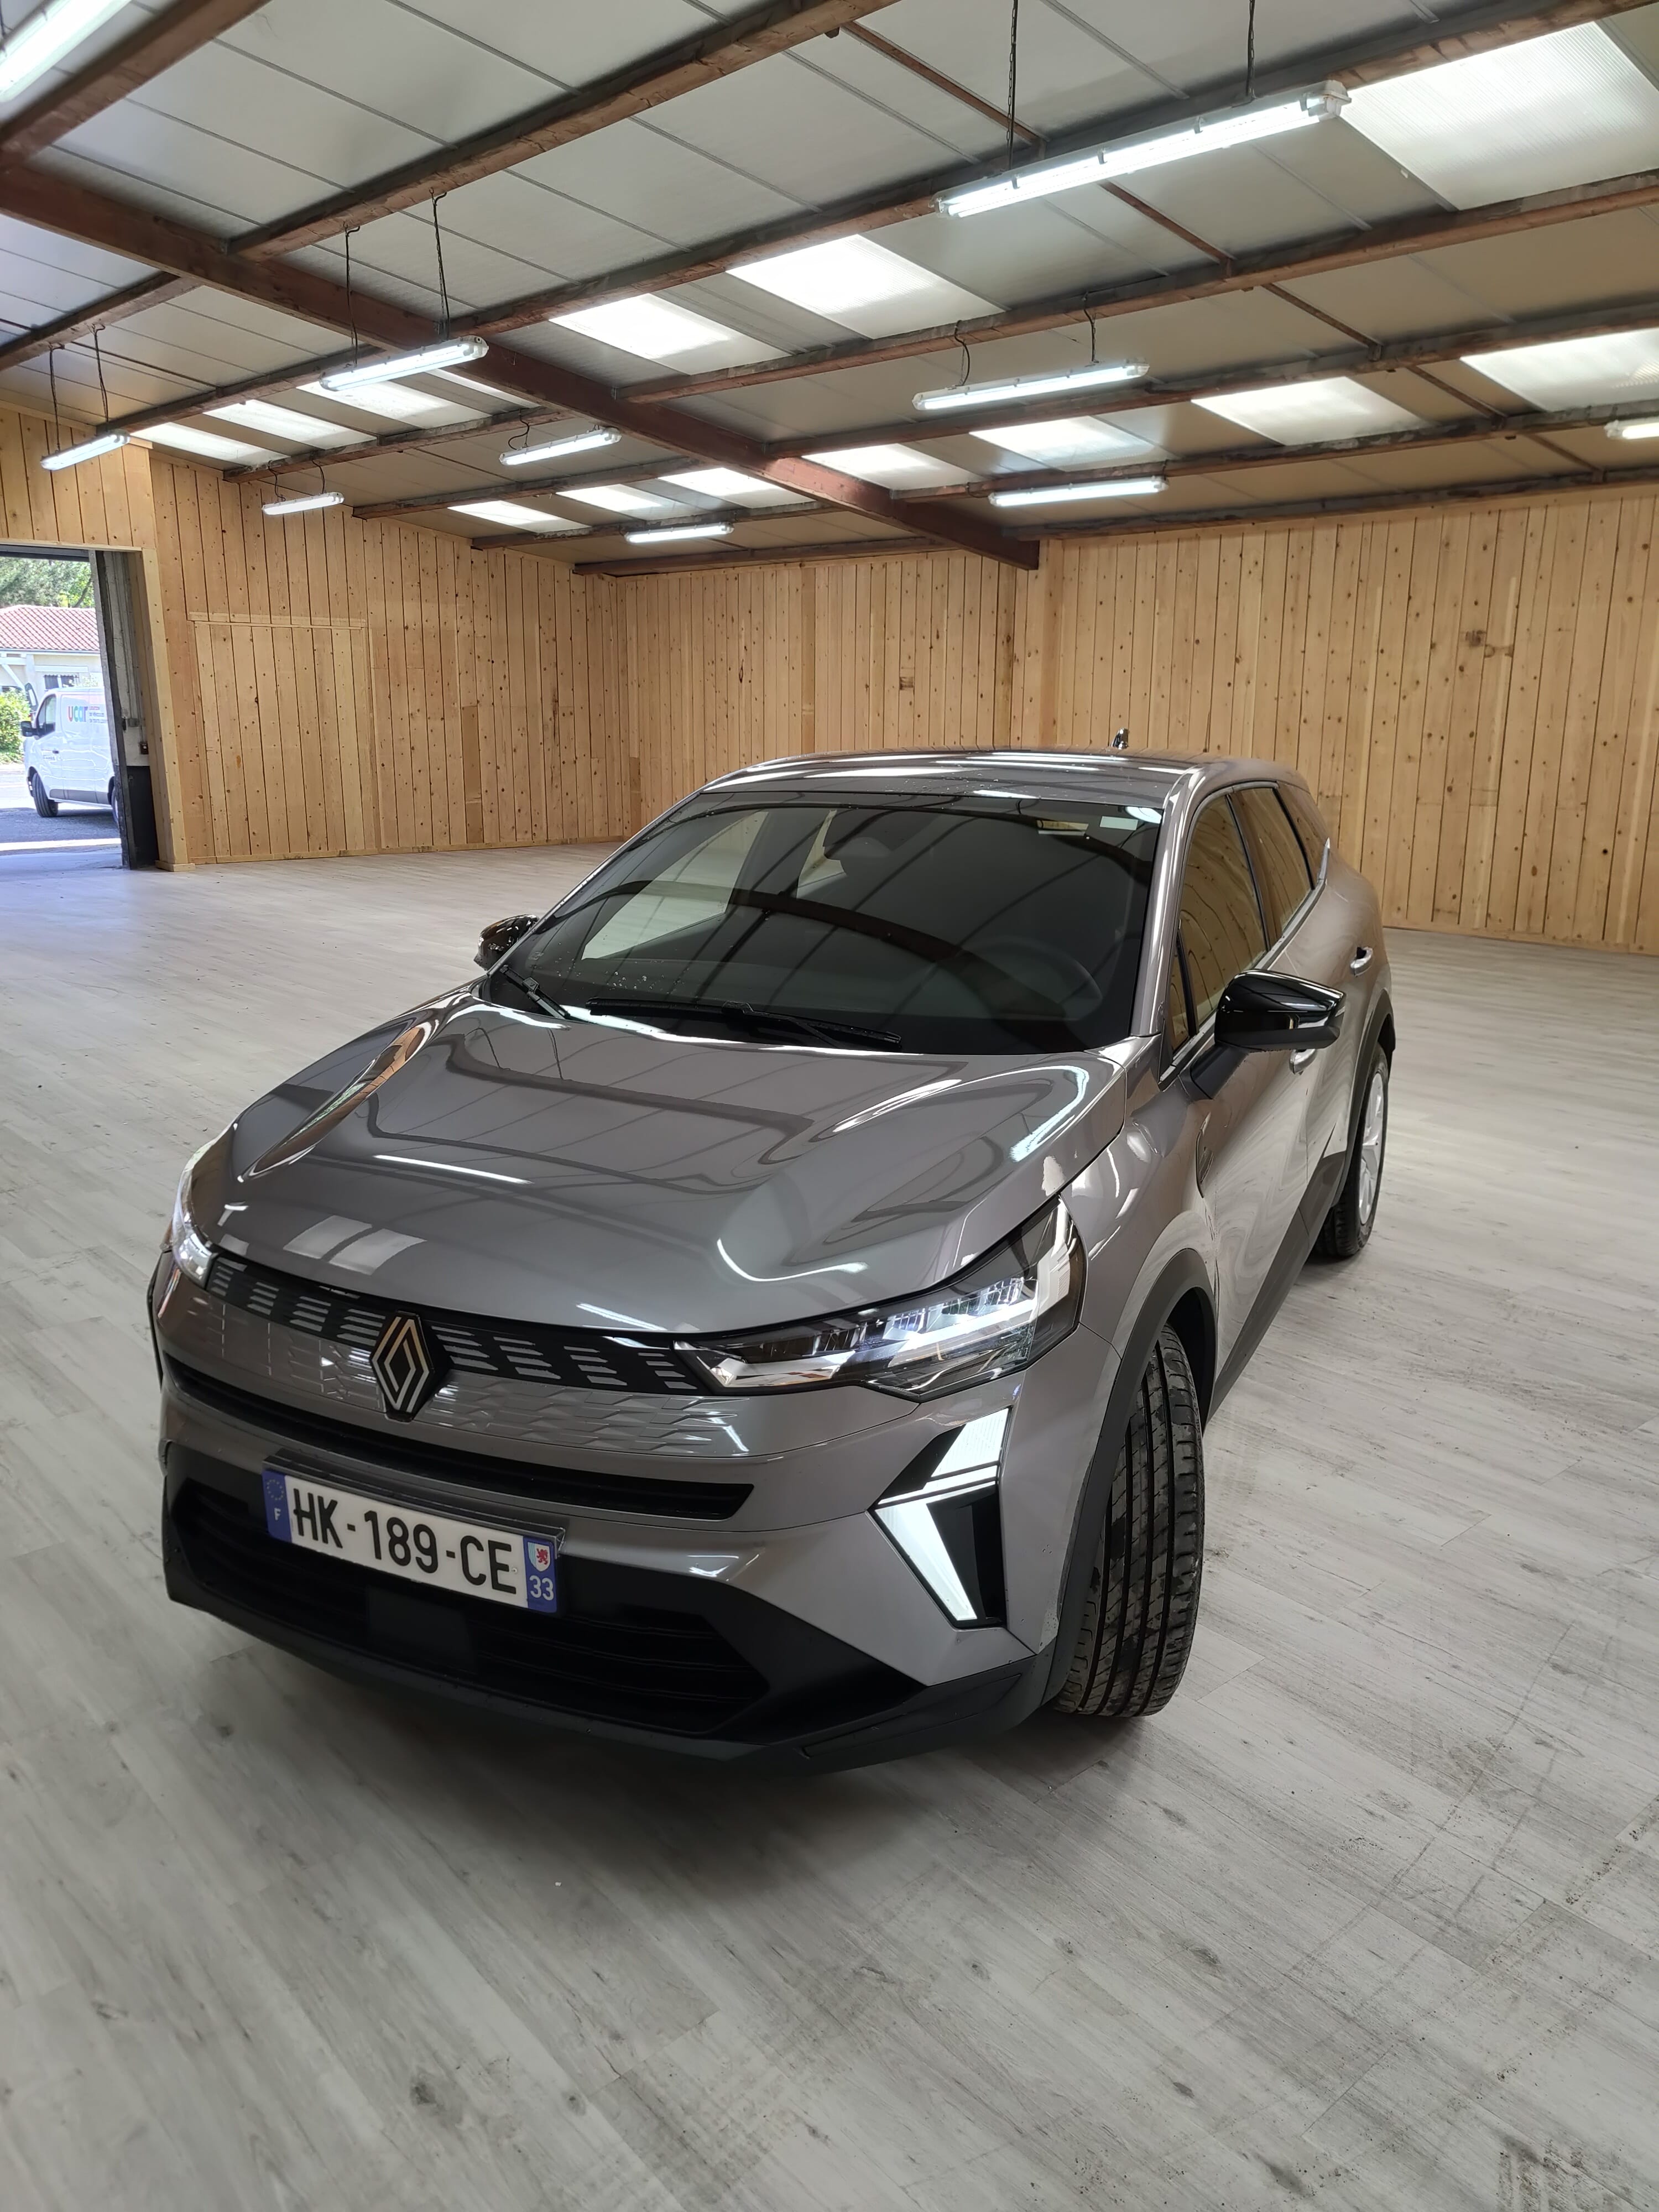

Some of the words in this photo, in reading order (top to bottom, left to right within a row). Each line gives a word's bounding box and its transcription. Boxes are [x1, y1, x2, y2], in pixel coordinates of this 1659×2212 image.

[68, 706, 88, 722] ucar
[274, 1507, 281, 1521] F
[293, 1488, 517, 1594] HK-189-CE
[529, 1575, 554, 1601] 33
